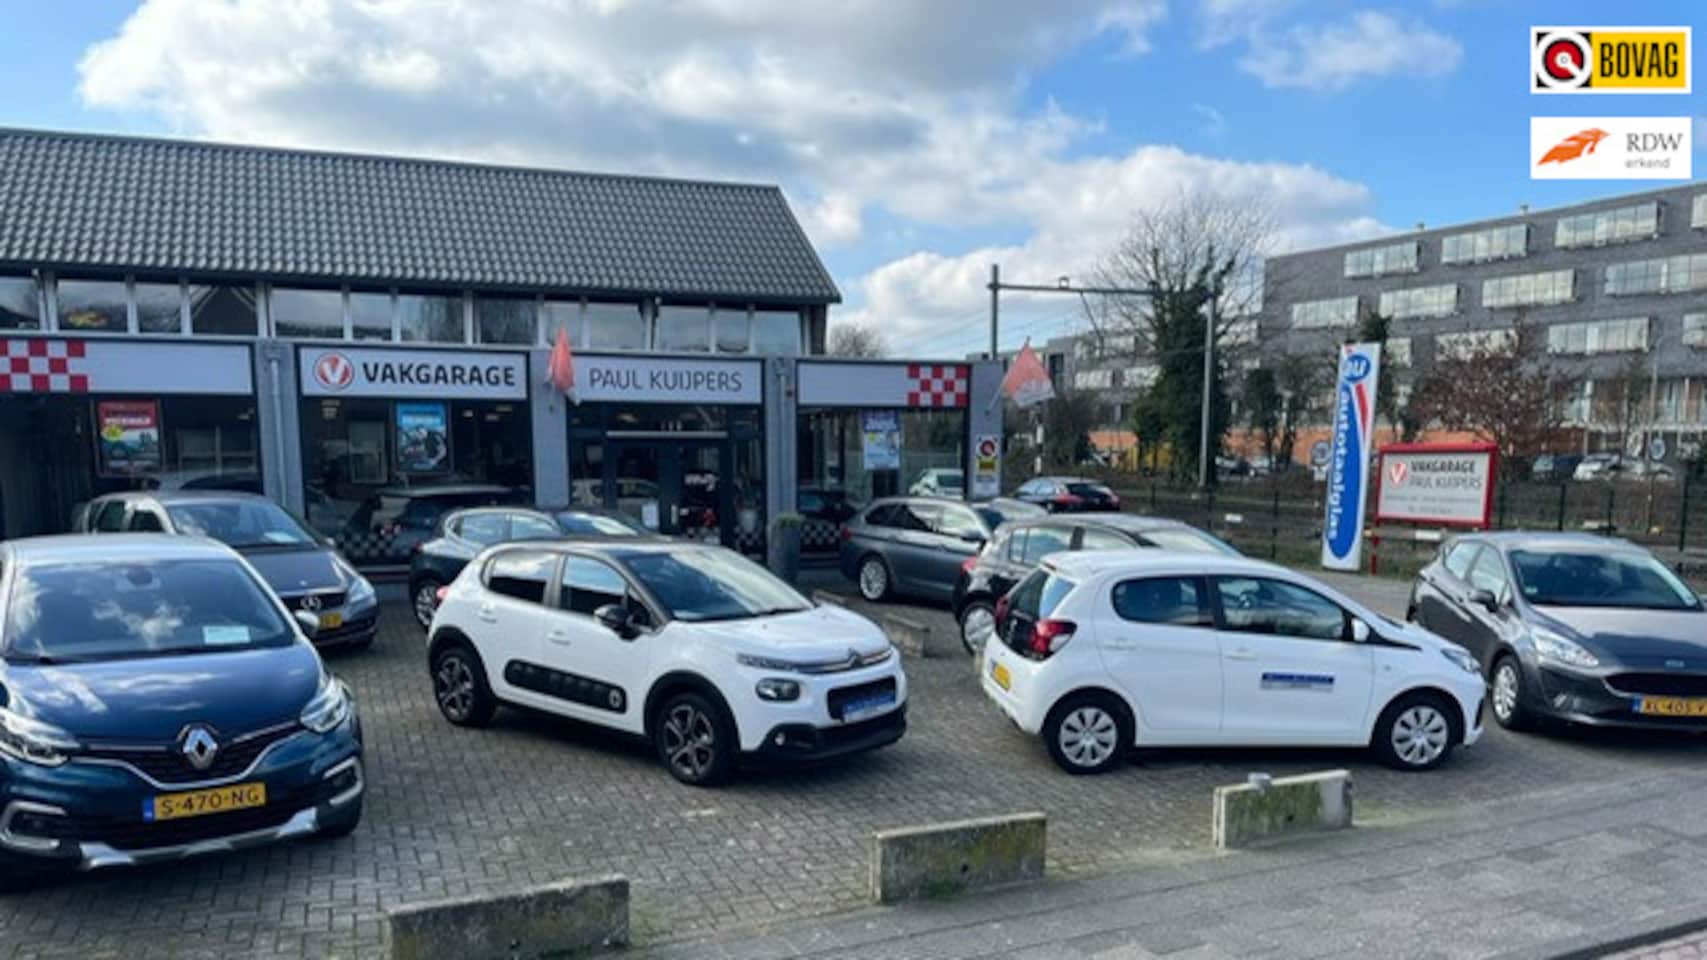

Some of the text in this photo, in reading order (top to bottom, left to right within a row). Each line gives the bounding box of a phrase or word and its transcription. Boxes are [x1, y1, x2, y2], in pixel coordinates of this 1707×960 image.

[363, 362, 516, 387] VAKGARAGE
[589, 368, 743, 392] PAUL KUIJPERS
[1327, 389, 1350, 541] autotaalglas
[1410, 460, 1476, 473] VAKGARAGE
[1409, 475, 1434, 488] PAUL
[161, 787, 260, 815] S-470-NG
